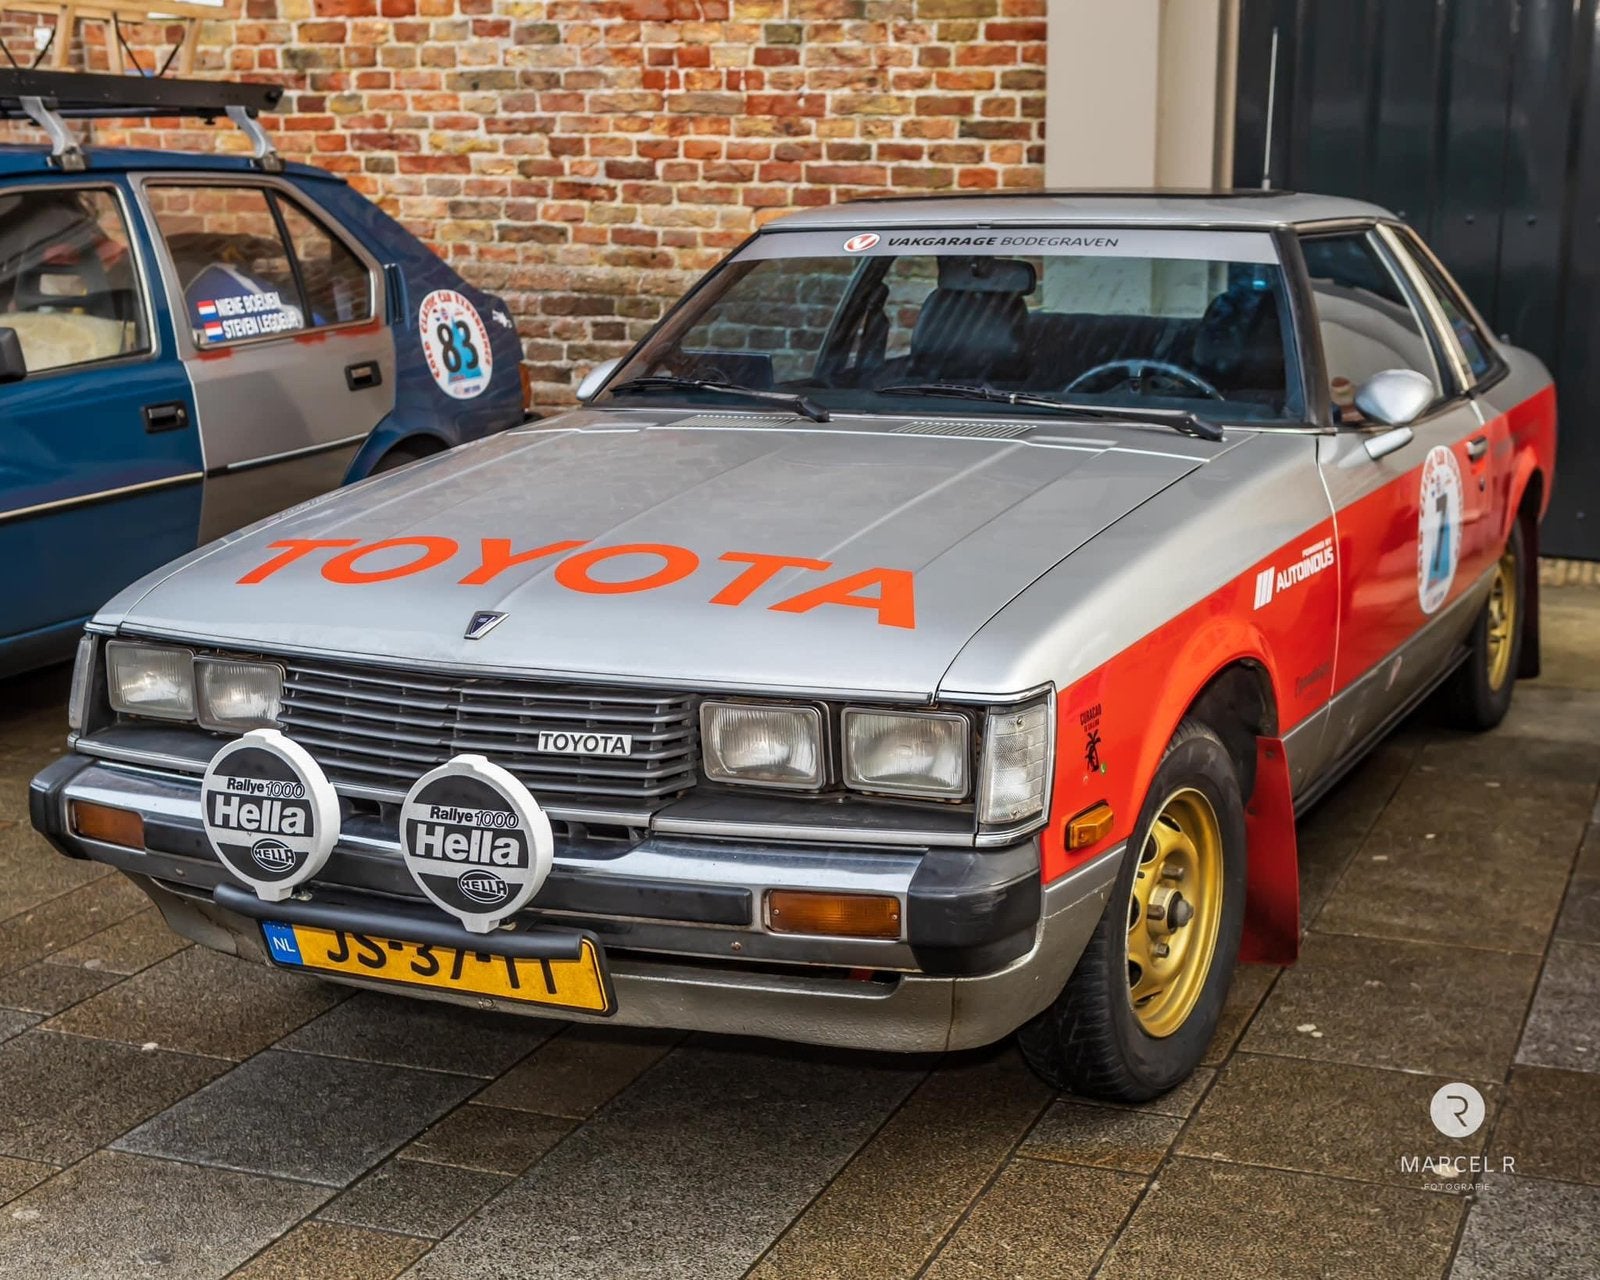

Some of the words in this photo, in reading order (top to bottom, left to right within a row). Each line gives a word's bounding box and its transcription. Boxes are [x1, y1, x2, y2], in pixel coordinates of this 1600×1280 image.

[888, 236, 998, 247] VAKGARAGE
[1000, 236, 1119, 248] BODEGRAVEN
[222, 316, 260, 339] STEVEN
[436, 320, 479, 373] 83
[235, 536, 917, 629] TOYOTA
[541, 732, 627, 754] TOYOTA
[226, 776, 265, 795] Rallye
[265, 780, 306, 799] 1000
[213, 794, 306, 835] Hella
[429, 806, 474, 823] Rallye
[474, 810, 520, 830] 1000
[254, 847, 296, 866] HELLA
[415, 824, 520, 866] Hella
[461, 879, 509, 897] HELLA
[273, 936, 296, 953] NL
